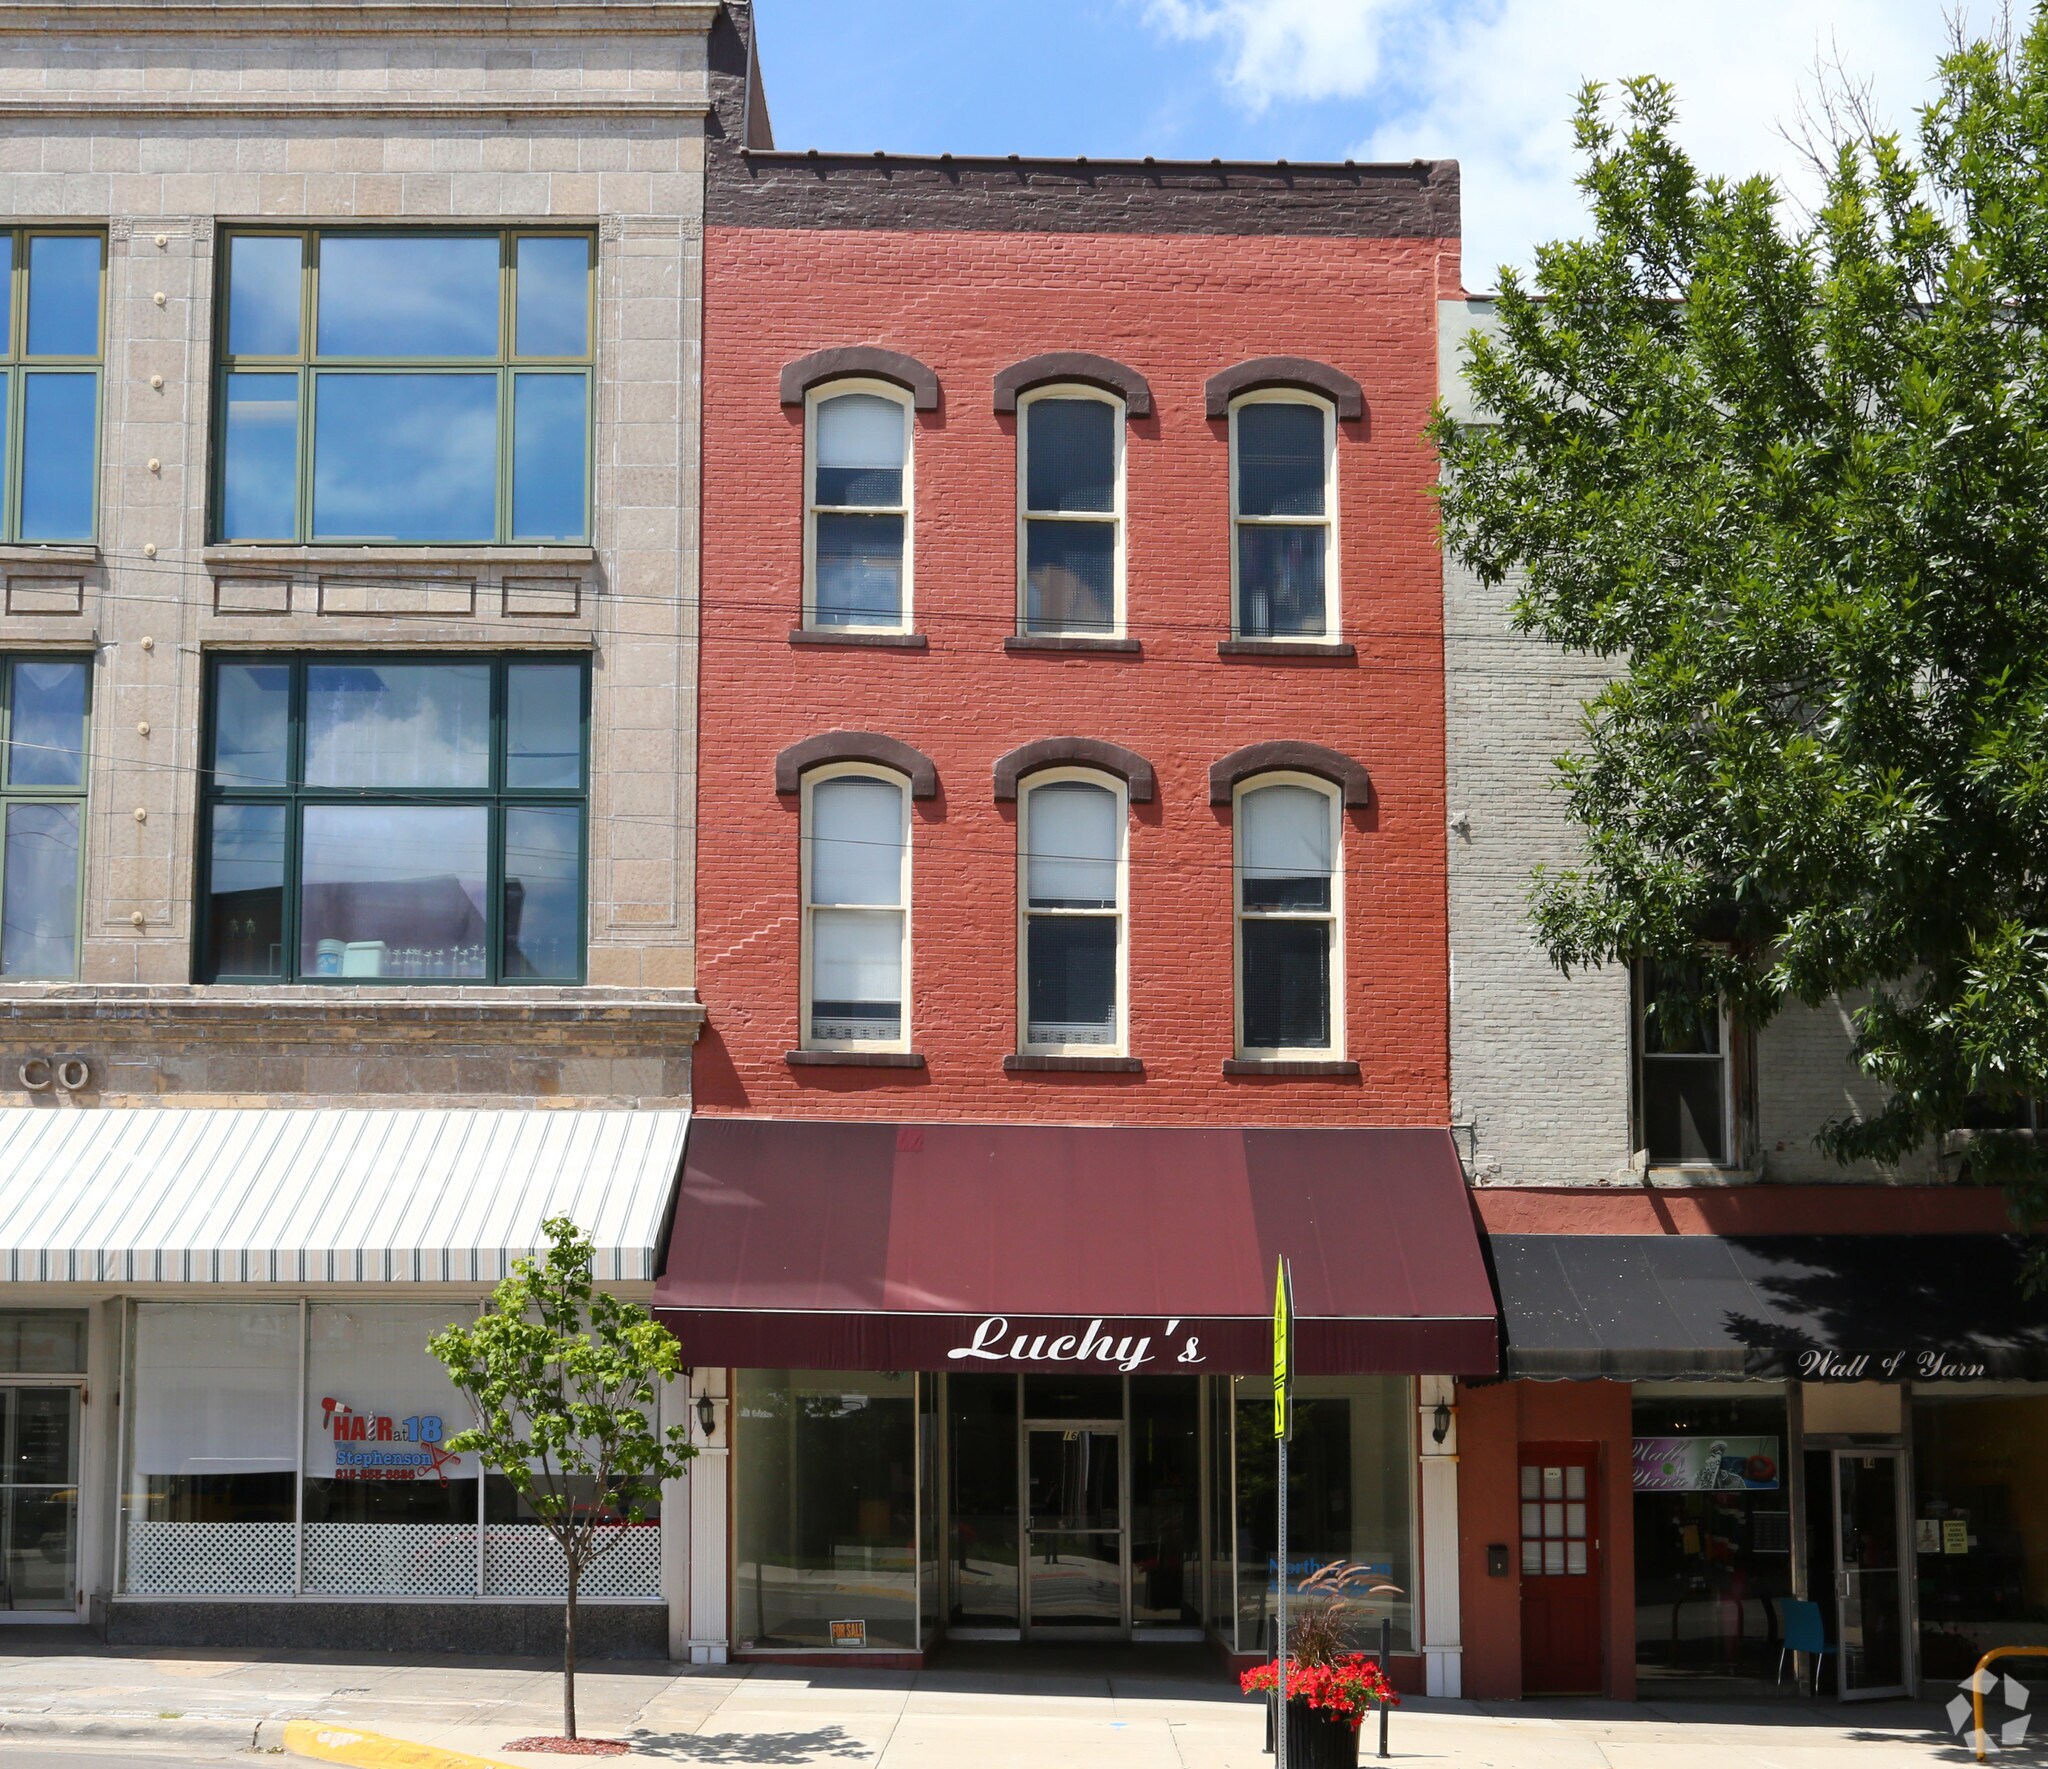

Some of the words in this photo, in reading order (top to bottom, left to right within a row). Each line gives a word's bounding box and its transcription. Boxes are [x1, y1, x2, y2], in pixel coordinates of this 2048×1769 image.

[18, 1057, 89, 1090] CO
[947, 1317, 1206, 1372] Luchy's
[1798, 1350, 1870, 1377] Wall
[1881, 1351, 1906, 1377] of
[1917, 1350, 1986, 1377] Yarn
[333, 1411, 393, 1441] HAIR
[393, 1430, 408, 1441] at
[402, 1415, 443, 1443] 18
[1065, 1431, 1078, 1440] 16
[336, 1450, 432, 1468] Stephenson
[1269, 1557, 1392, 1575] Northrn
[832, 1623, 846, 1638] FOR
[846, 1623, 864, 1638] SALE
